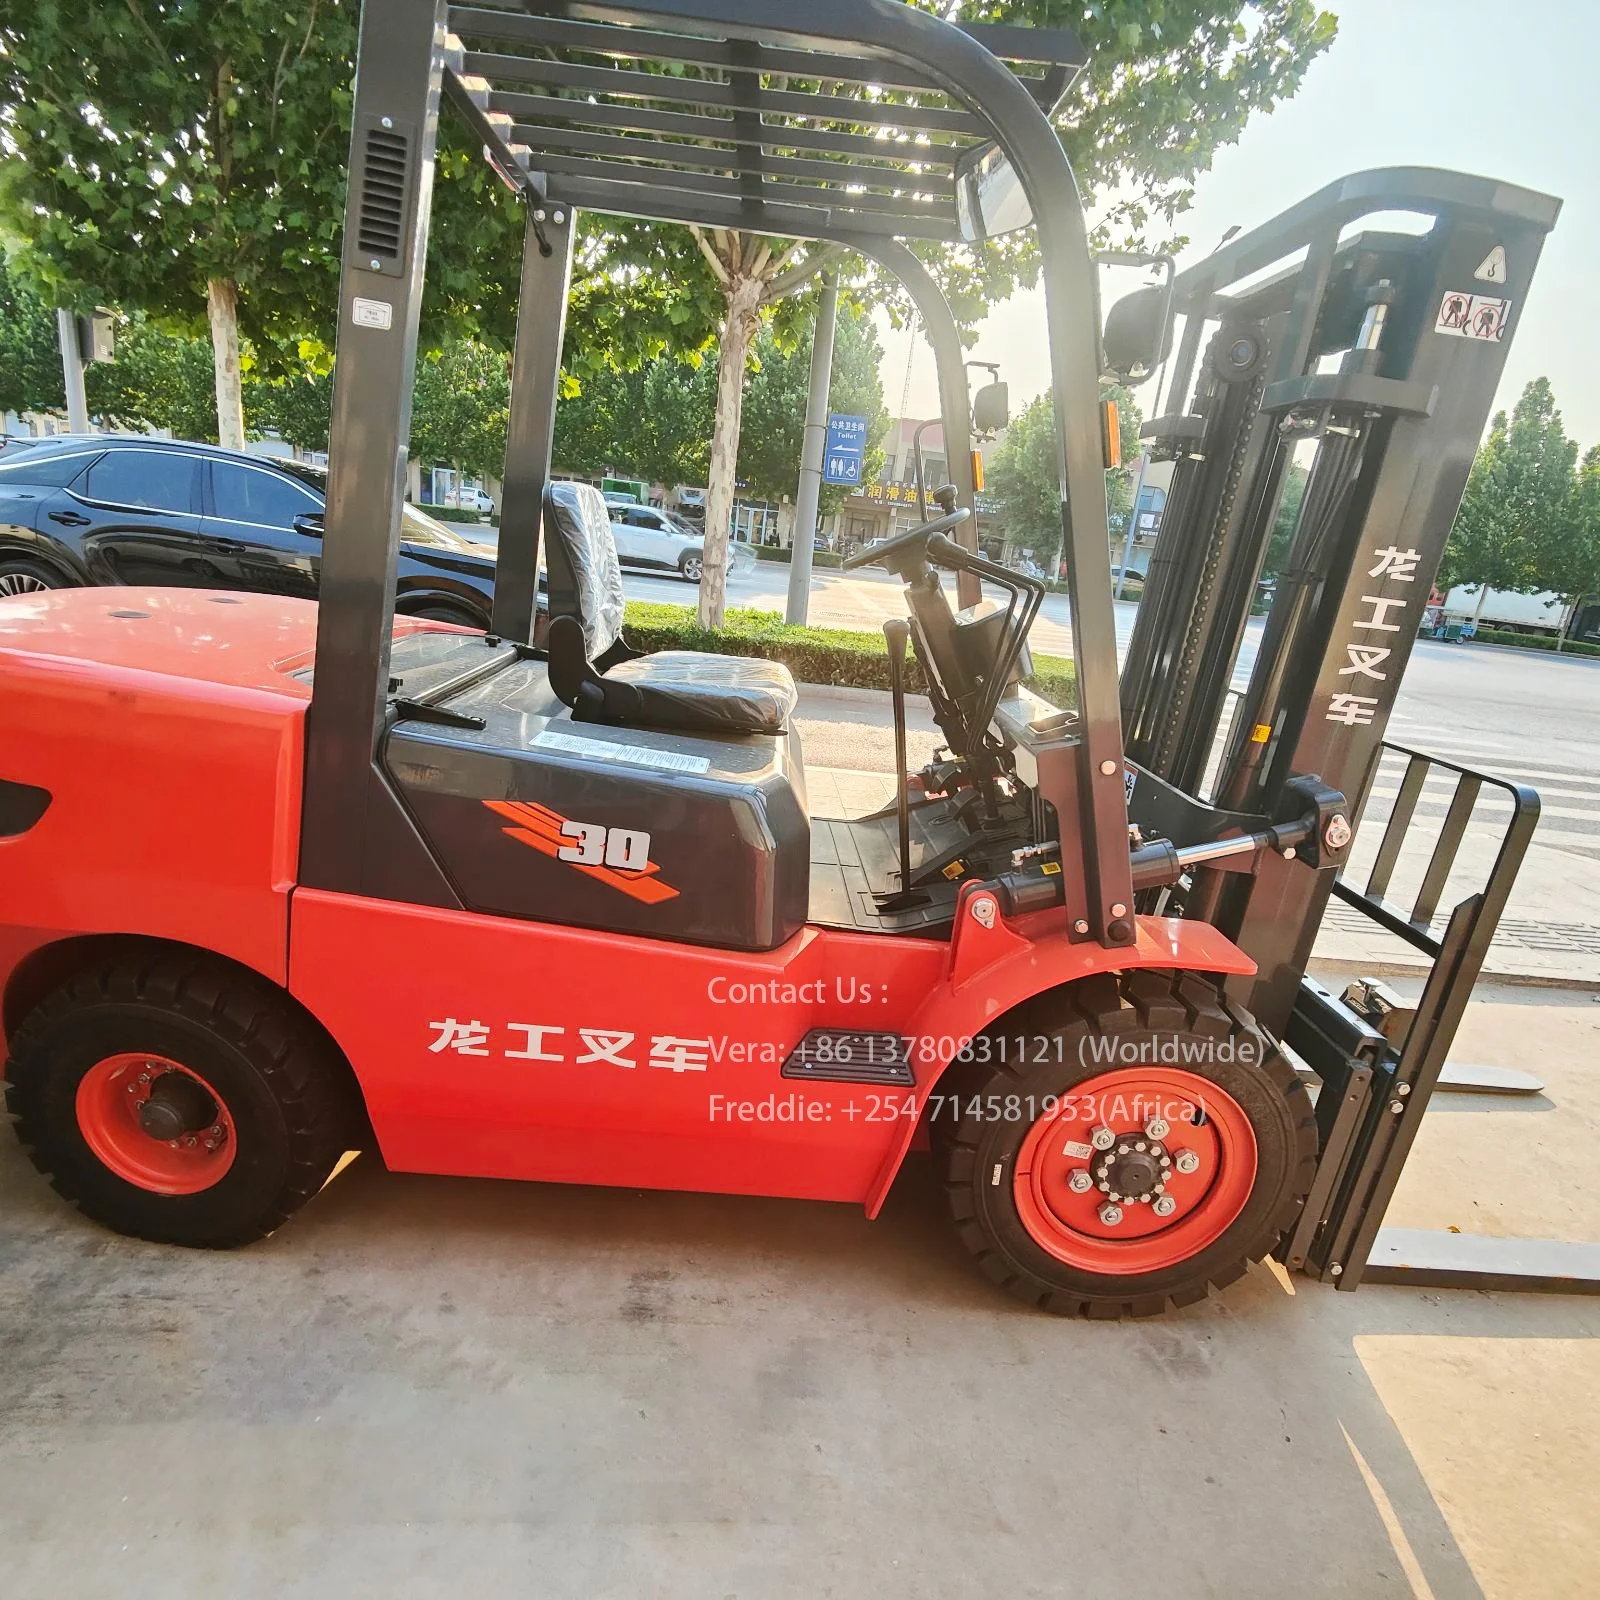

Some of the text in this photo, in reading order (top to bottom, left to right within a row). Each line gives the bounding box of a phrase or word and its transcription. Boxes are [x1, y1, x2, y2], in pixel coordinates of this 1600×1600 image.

[831, 420, 865, 432] 公共卫生间
[838, 432, 857, 440] Toilet
[1325, 545, 1421, 725] 龙工叉车
[557, 820, 650, 872] 30
[428, 1017, 710, 1073] 龙工叉车
